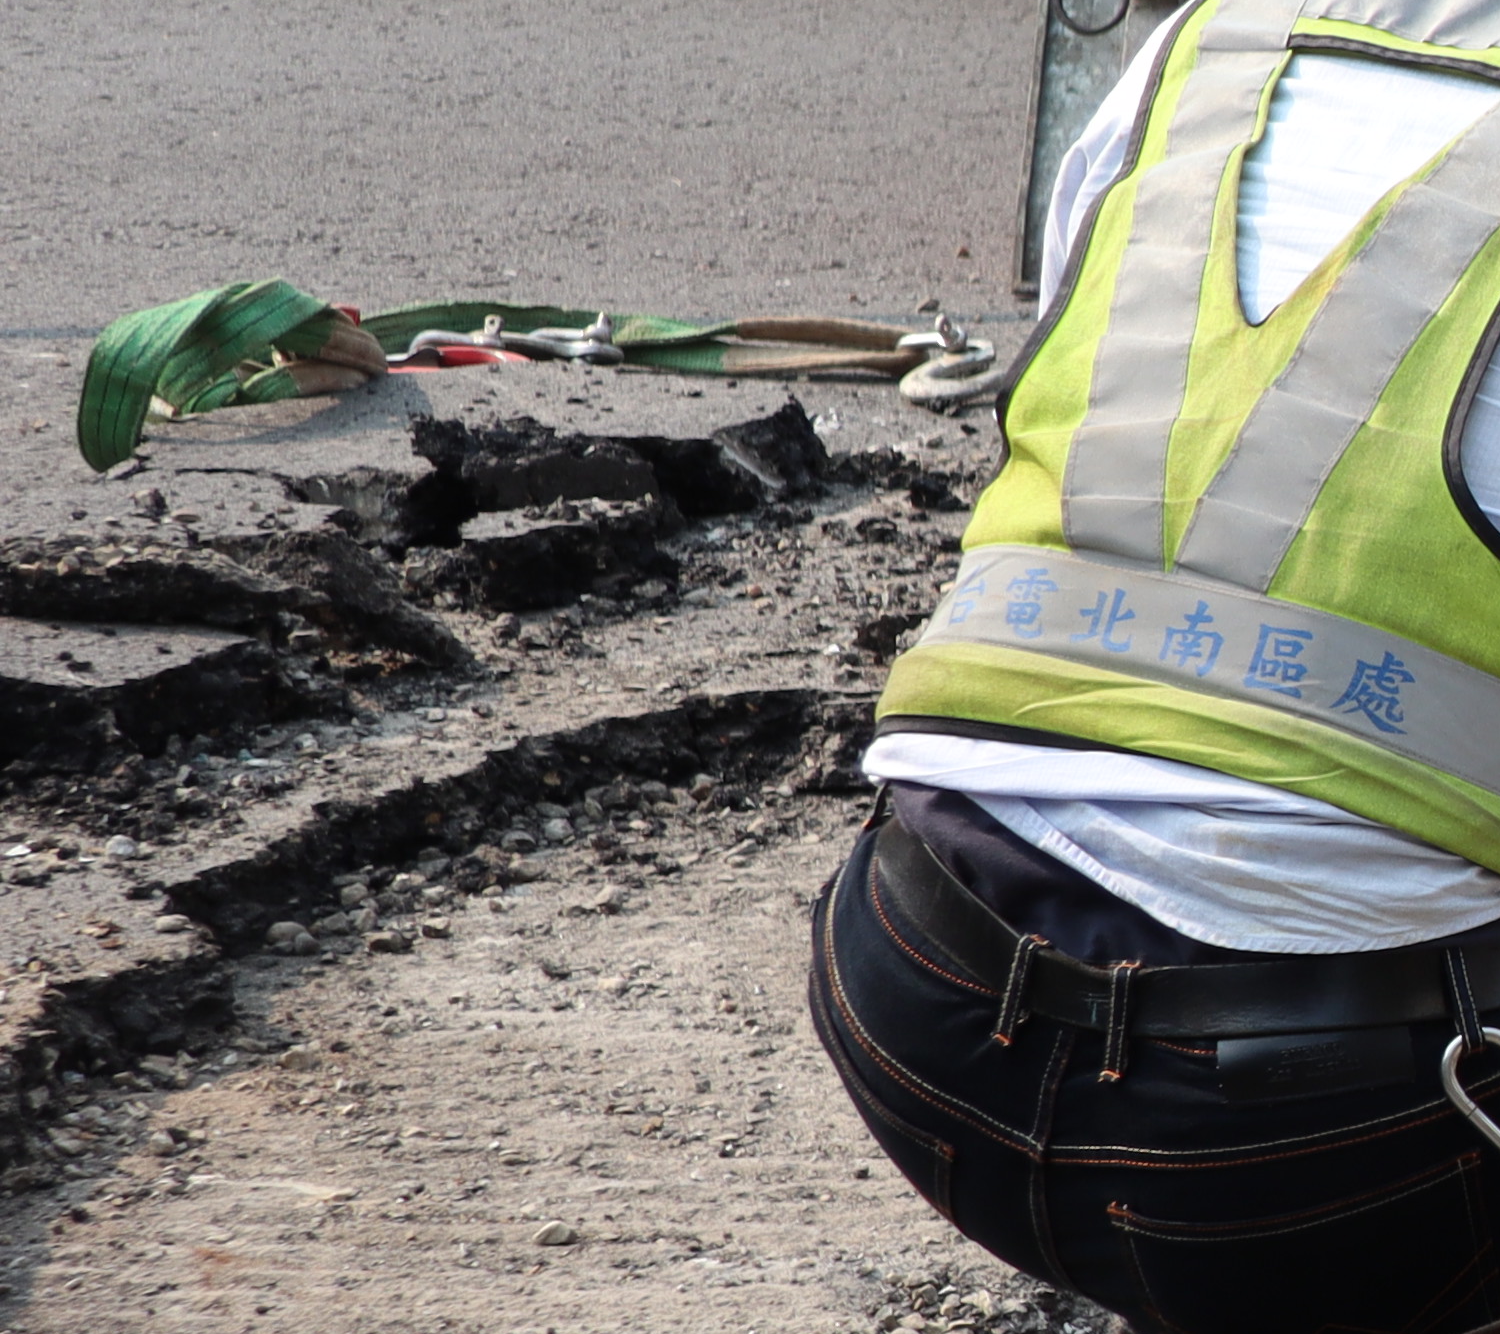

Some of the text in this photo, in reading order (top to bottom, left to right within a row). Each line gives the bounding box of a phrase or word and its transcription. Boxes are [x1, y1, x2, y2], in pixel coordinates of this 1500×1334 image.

[948, 565, 1416, 736] 台電北南區處
